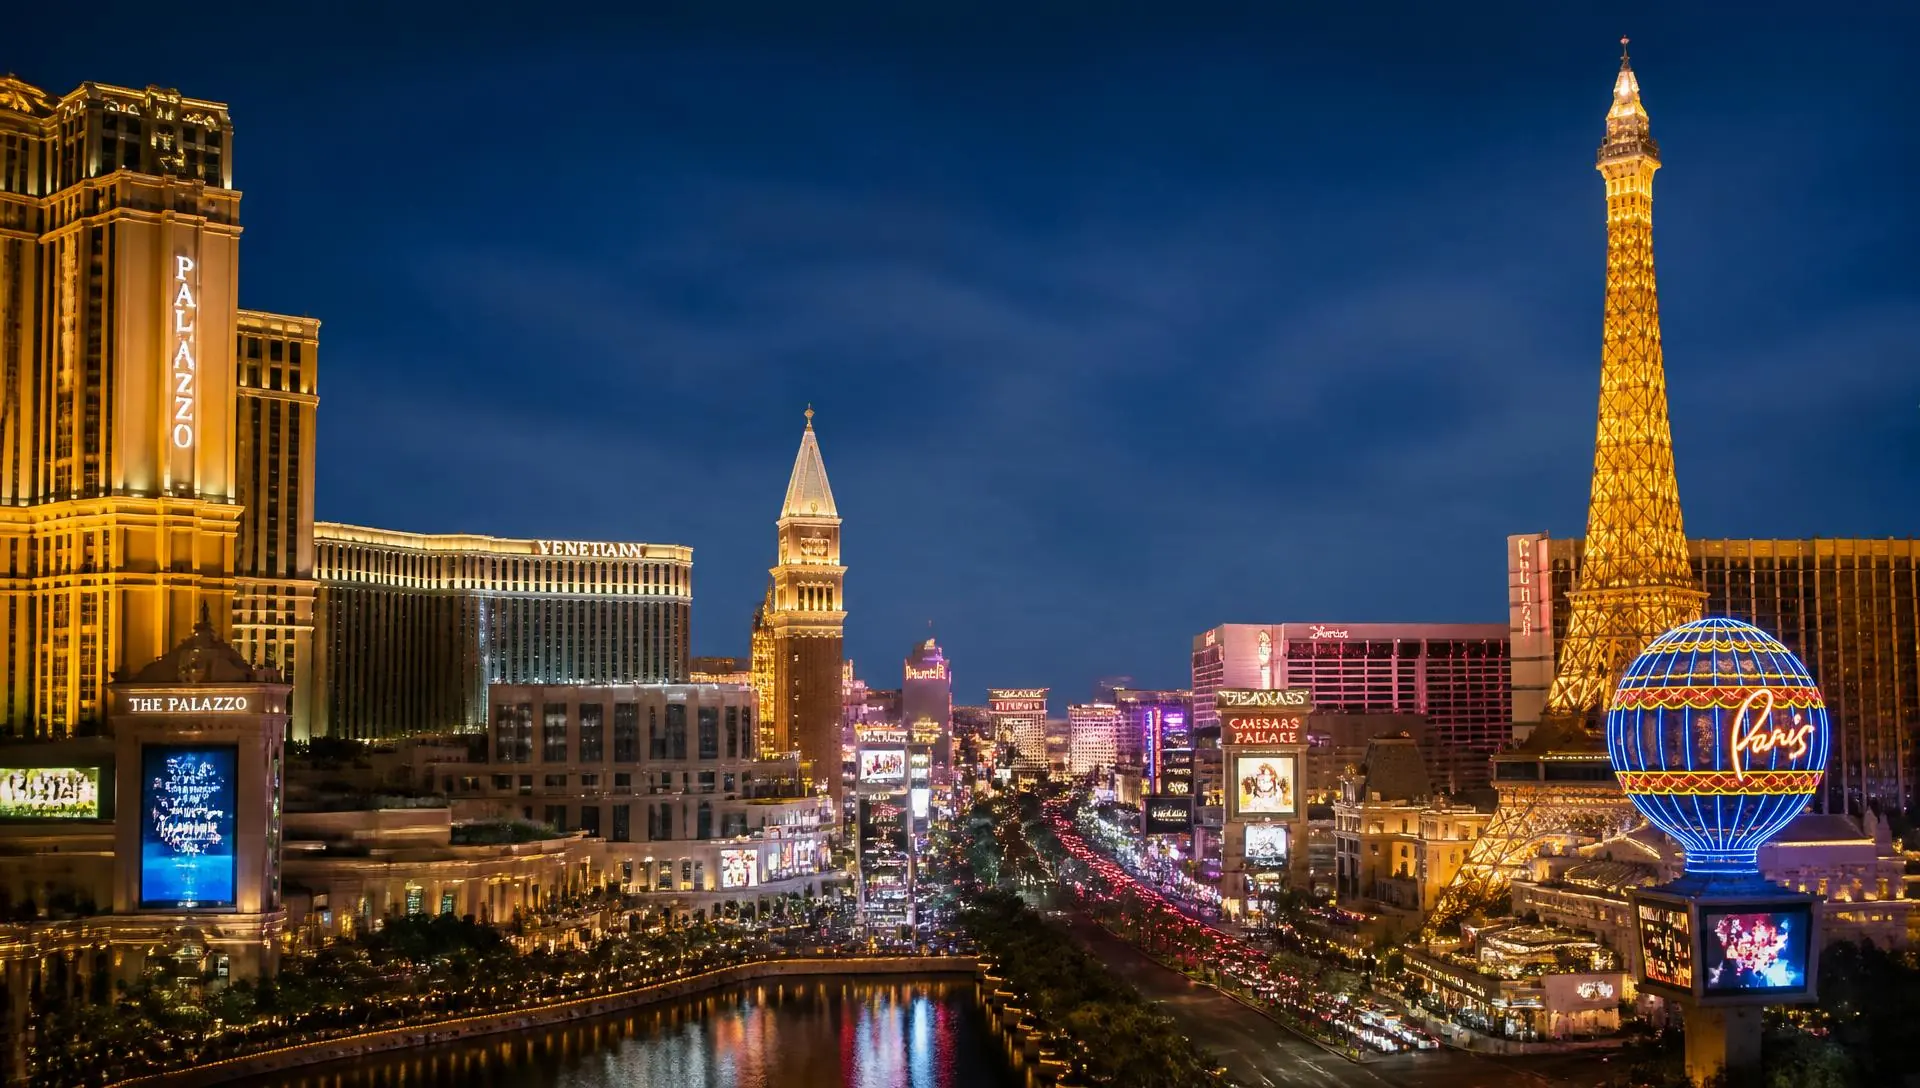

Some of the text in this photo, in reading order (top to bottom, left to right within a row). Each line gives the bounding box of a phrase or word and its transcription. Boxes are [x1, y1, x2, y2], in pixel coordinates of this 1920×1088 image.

[173, 255, 196, 449] PALAZZO
[128, 696, 248, 711] THE PALAZZO
[1731, 688, 1815, 782] Paris
